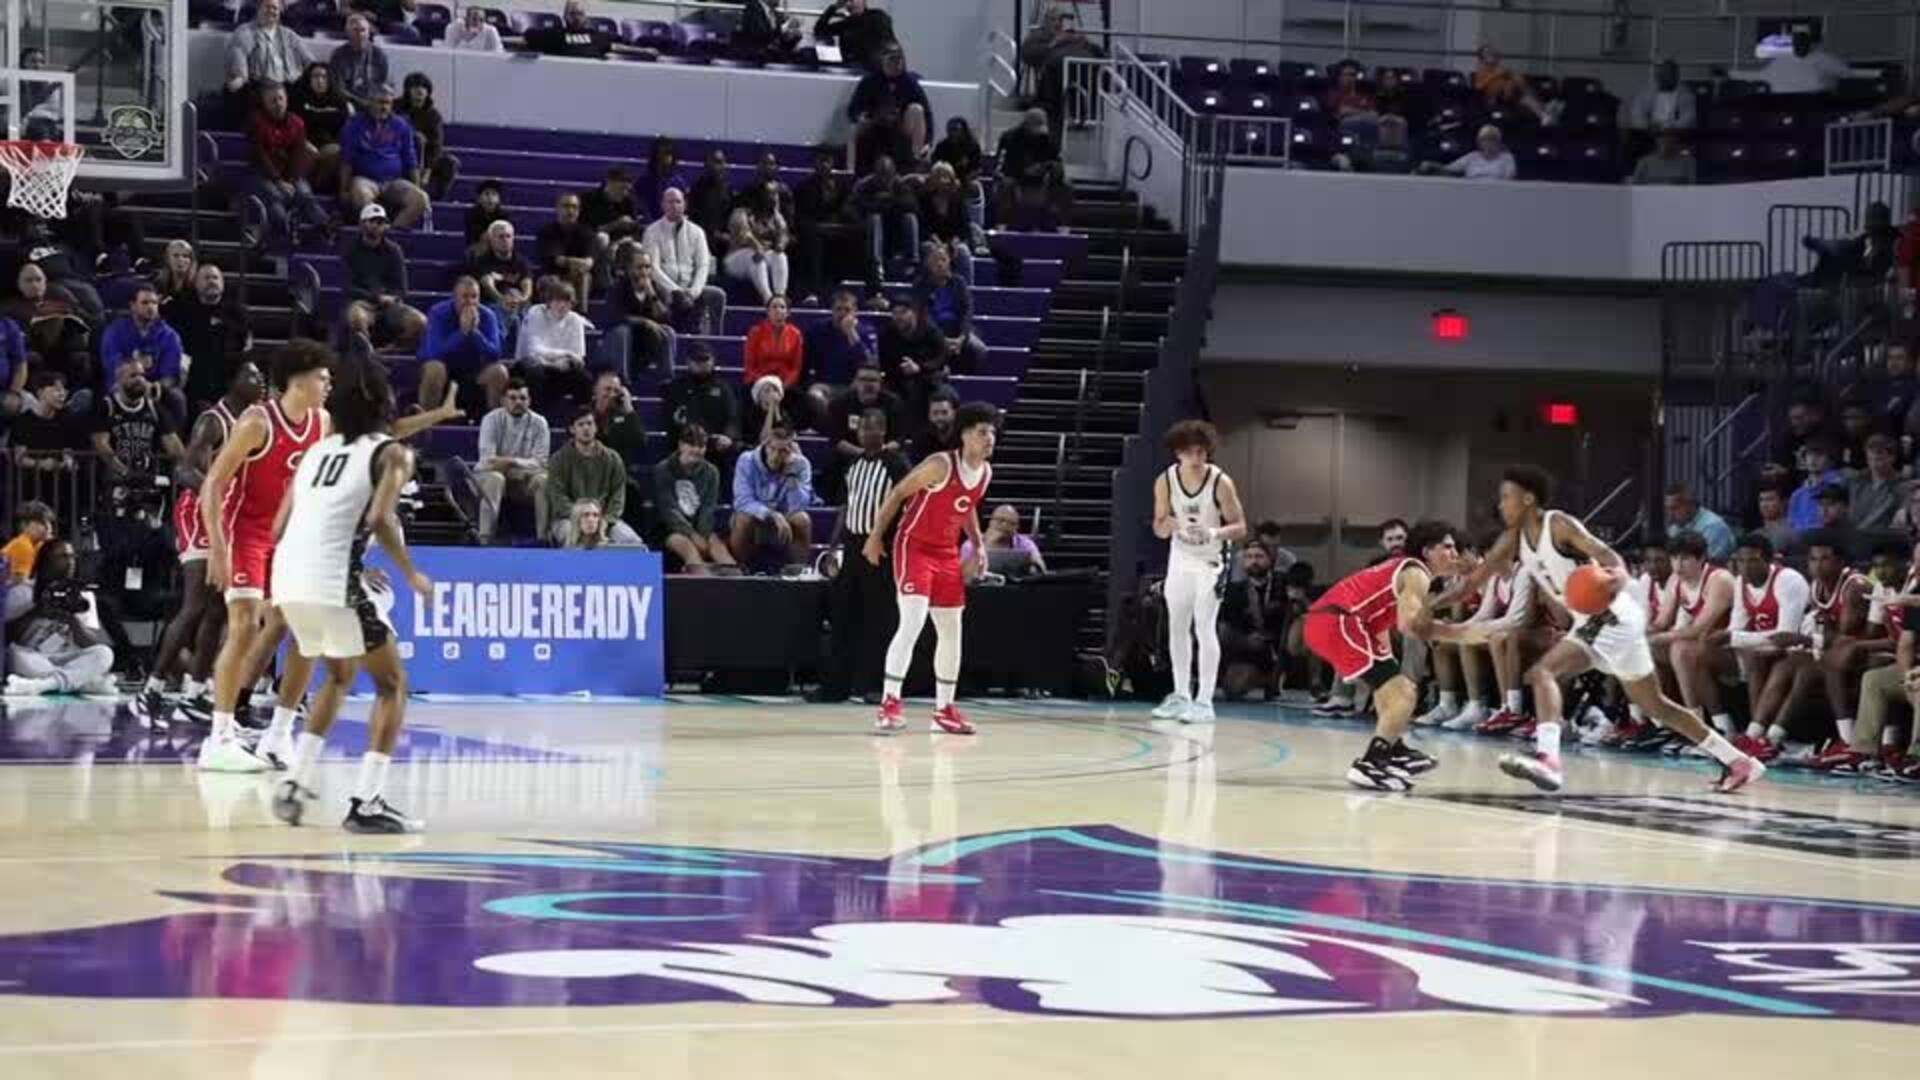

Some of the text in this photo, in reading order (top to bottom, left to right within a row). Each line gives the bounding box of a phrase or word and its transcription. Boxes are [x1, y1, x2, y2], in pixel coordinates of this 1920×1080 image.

[311, 453, 350, 488] 10
[954, 496, 971, 512] C
[233, 572, 248, 585] C
[903, 582, 915, 592] C
[414, 582, 653, 640] LEAGUEREADY
